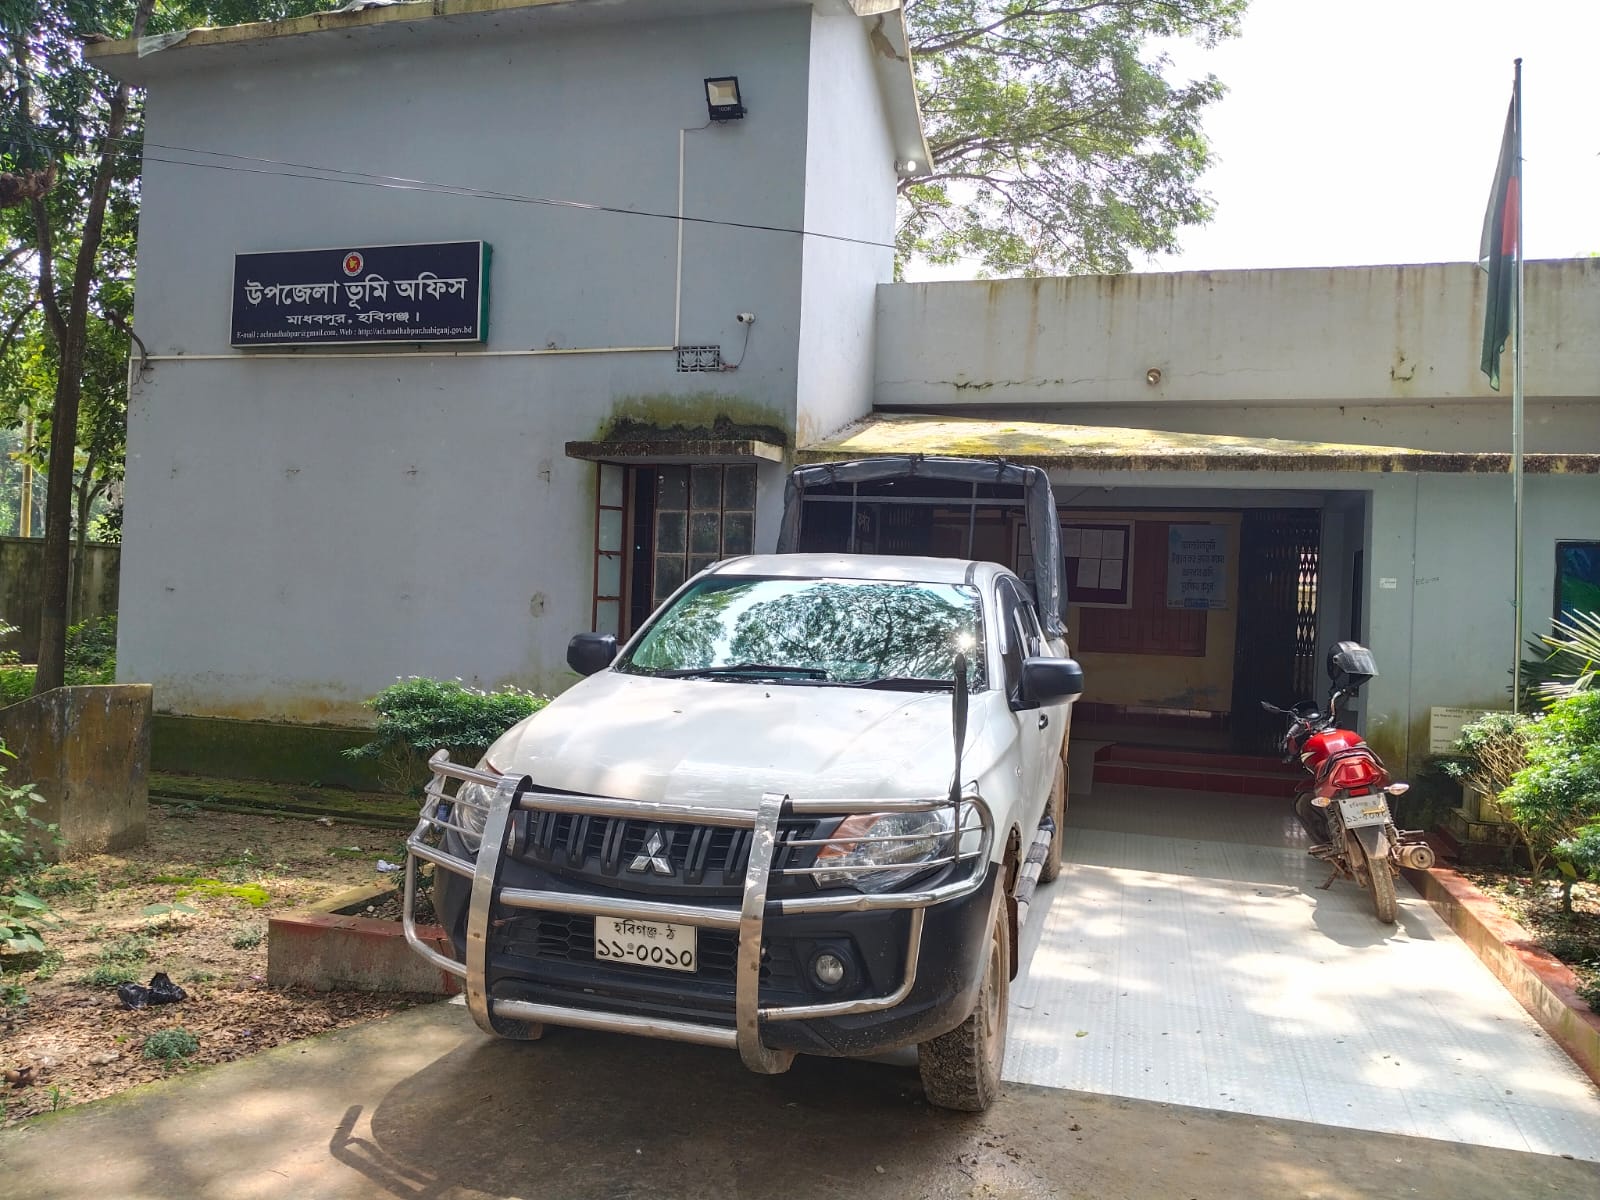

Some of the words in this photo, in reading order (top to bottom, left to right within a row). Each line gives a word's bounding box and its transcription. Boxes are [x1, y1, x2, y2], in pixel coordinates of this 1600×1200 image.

[245, 280, 340, 306] উপজেলা
[343, 274, 389, 310] ভূমি
[393, 272, 468, 301] অফিস
[597, 939, 693, 967] ১১-০০১০
